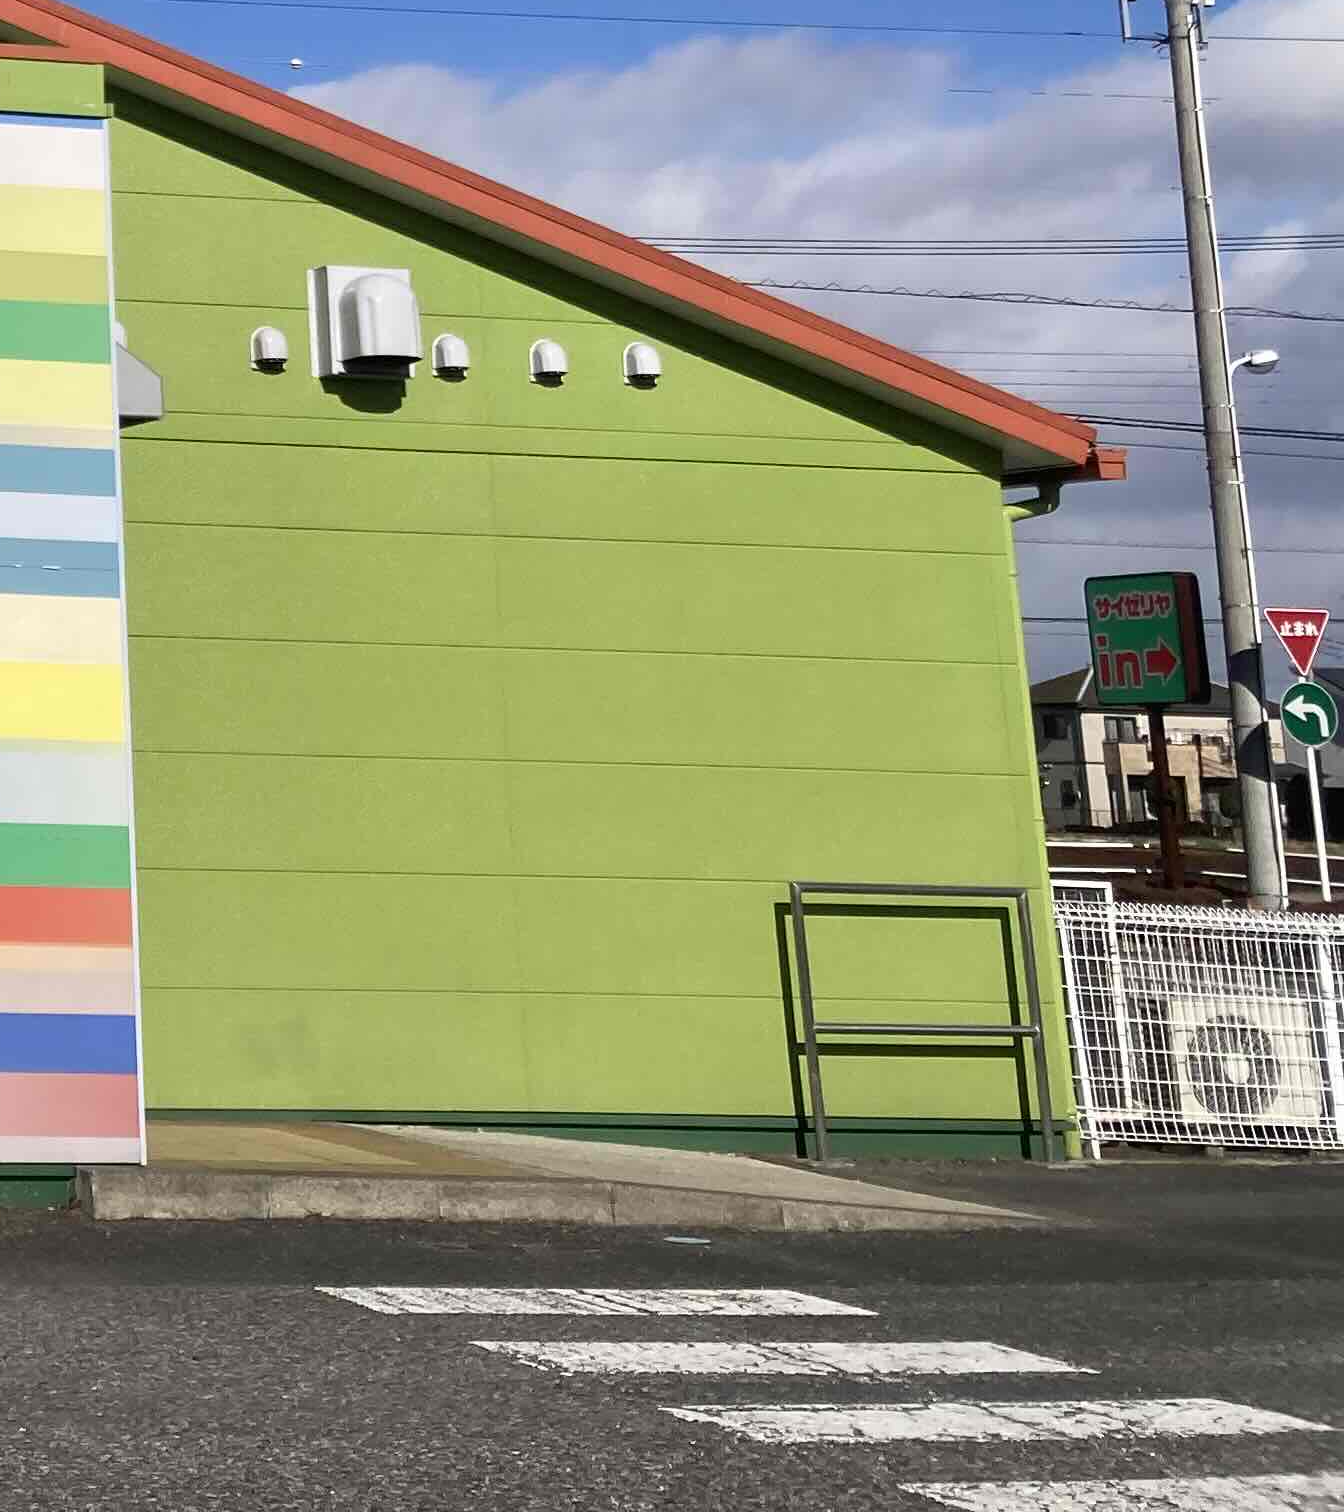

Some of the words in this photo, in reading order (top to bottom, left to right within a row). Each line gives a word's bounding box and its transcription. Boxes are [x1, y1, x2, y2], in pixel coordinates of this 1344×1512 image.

[1095, 592, 1172, 620] サイゼリヤ
[1279, 620, 1320, 637] 止まれ
[1096, 634, 1142, 688] in
